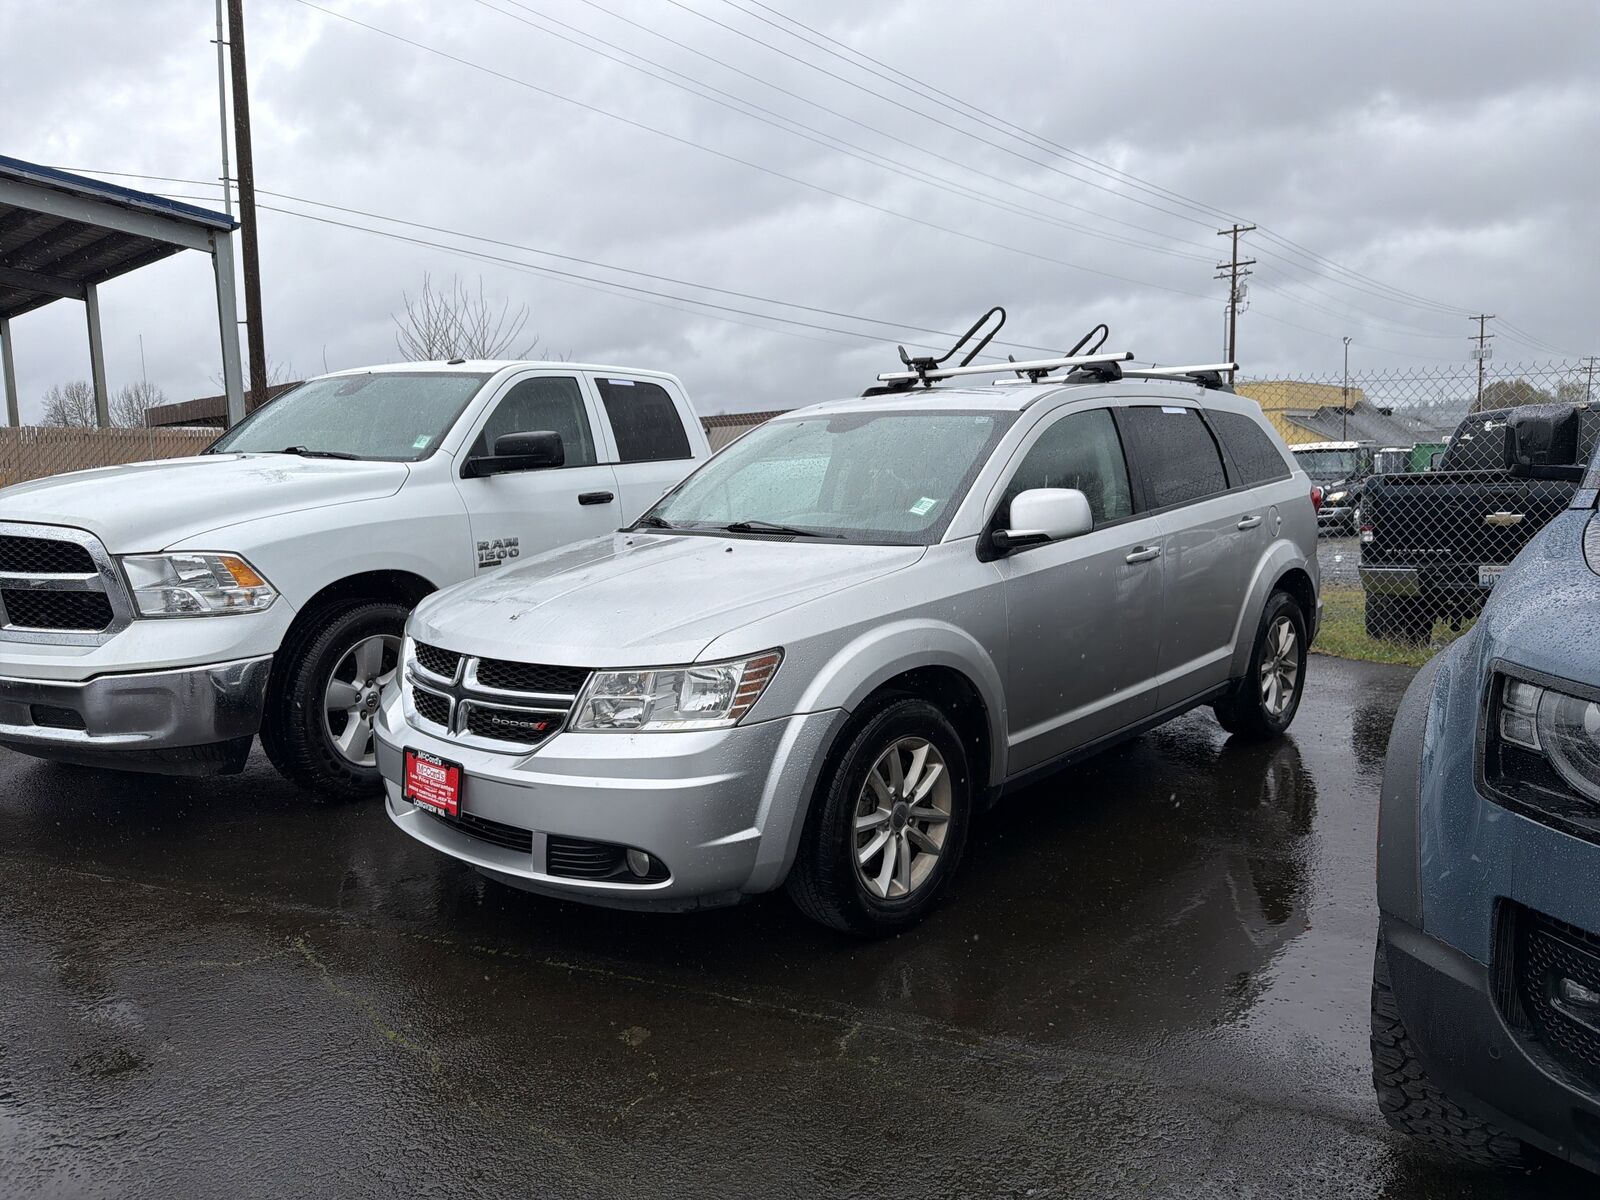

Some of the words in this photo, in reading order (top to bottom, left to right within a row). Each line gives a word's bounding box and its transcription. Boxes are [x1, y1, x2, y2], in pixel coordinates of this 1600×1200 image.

[477, 538, 518, 551] RAM
[478, 549, 519, 561] 1500
[491, 717, 537, 730] DODGE
[418, 750, 442, 766] McCord's
[418, 764, 444, 780] McCord's
[418, 775, 429, 784] Price
[414, 798, 436, 812] LONGVIEW
